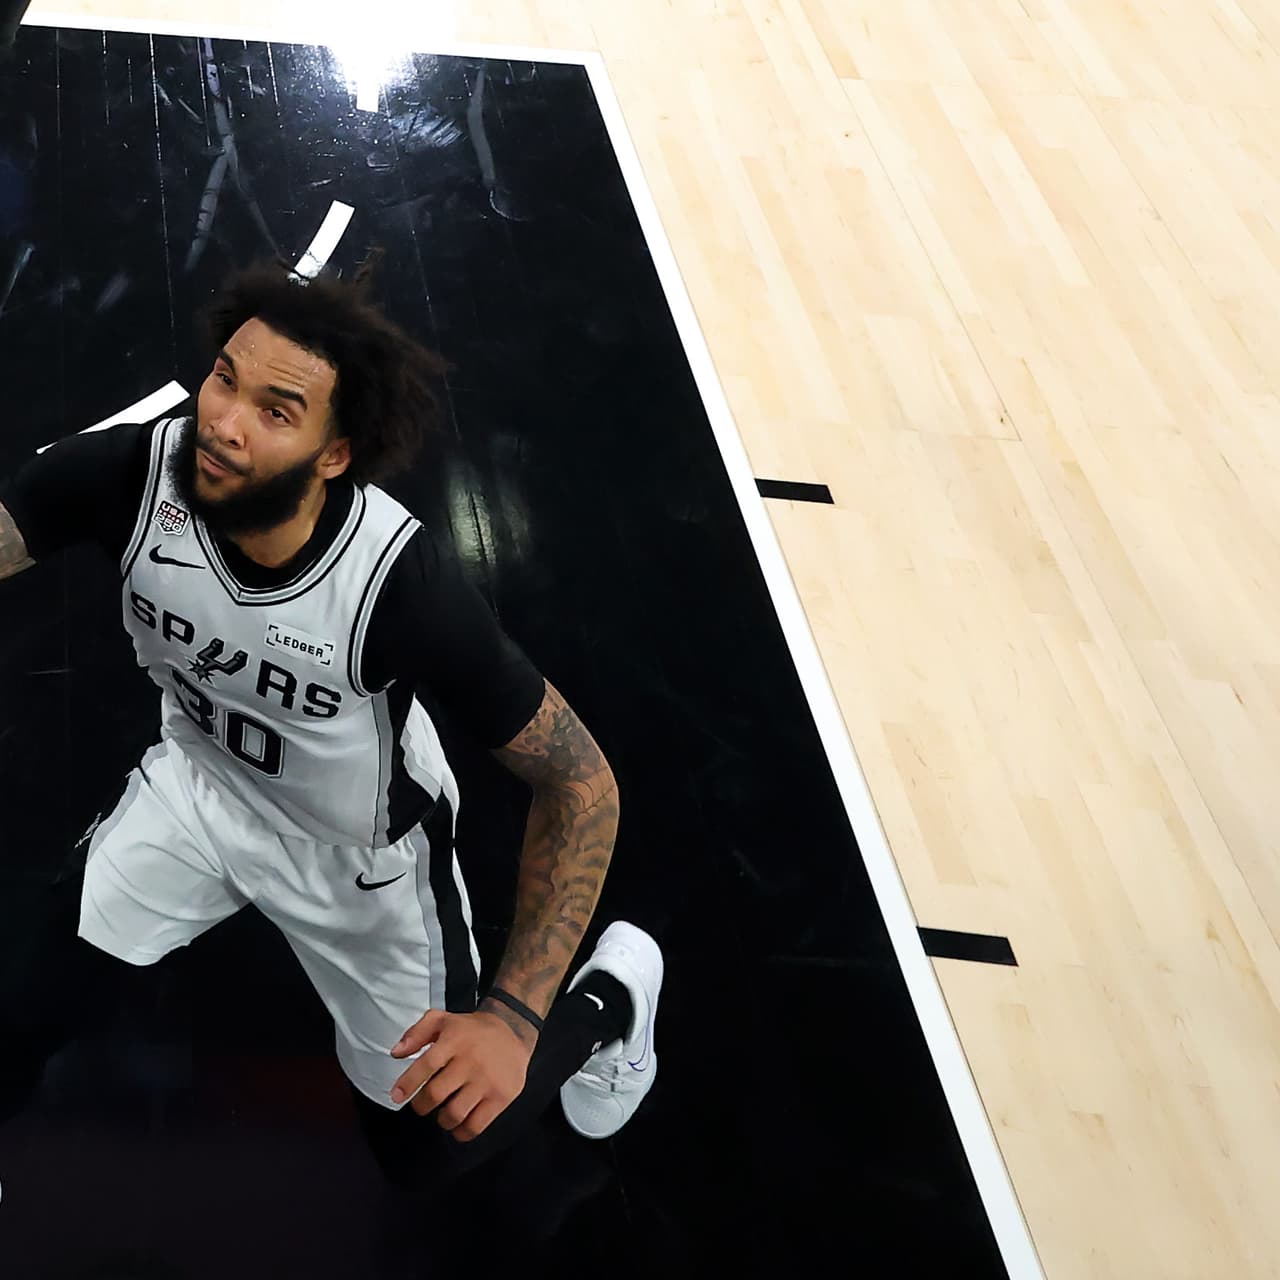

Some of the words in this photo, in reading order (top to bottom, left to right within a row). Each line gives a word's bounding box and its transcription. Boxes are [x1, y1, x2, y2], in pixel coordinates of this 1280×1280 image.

[155, 513, 182, 532] 250
[161, 502, 185, 520] USA
[130, 591, 342, 719] SPURS
[275, 633, 324, 658] LEDGER
[171, 668, 286, 779] 30
